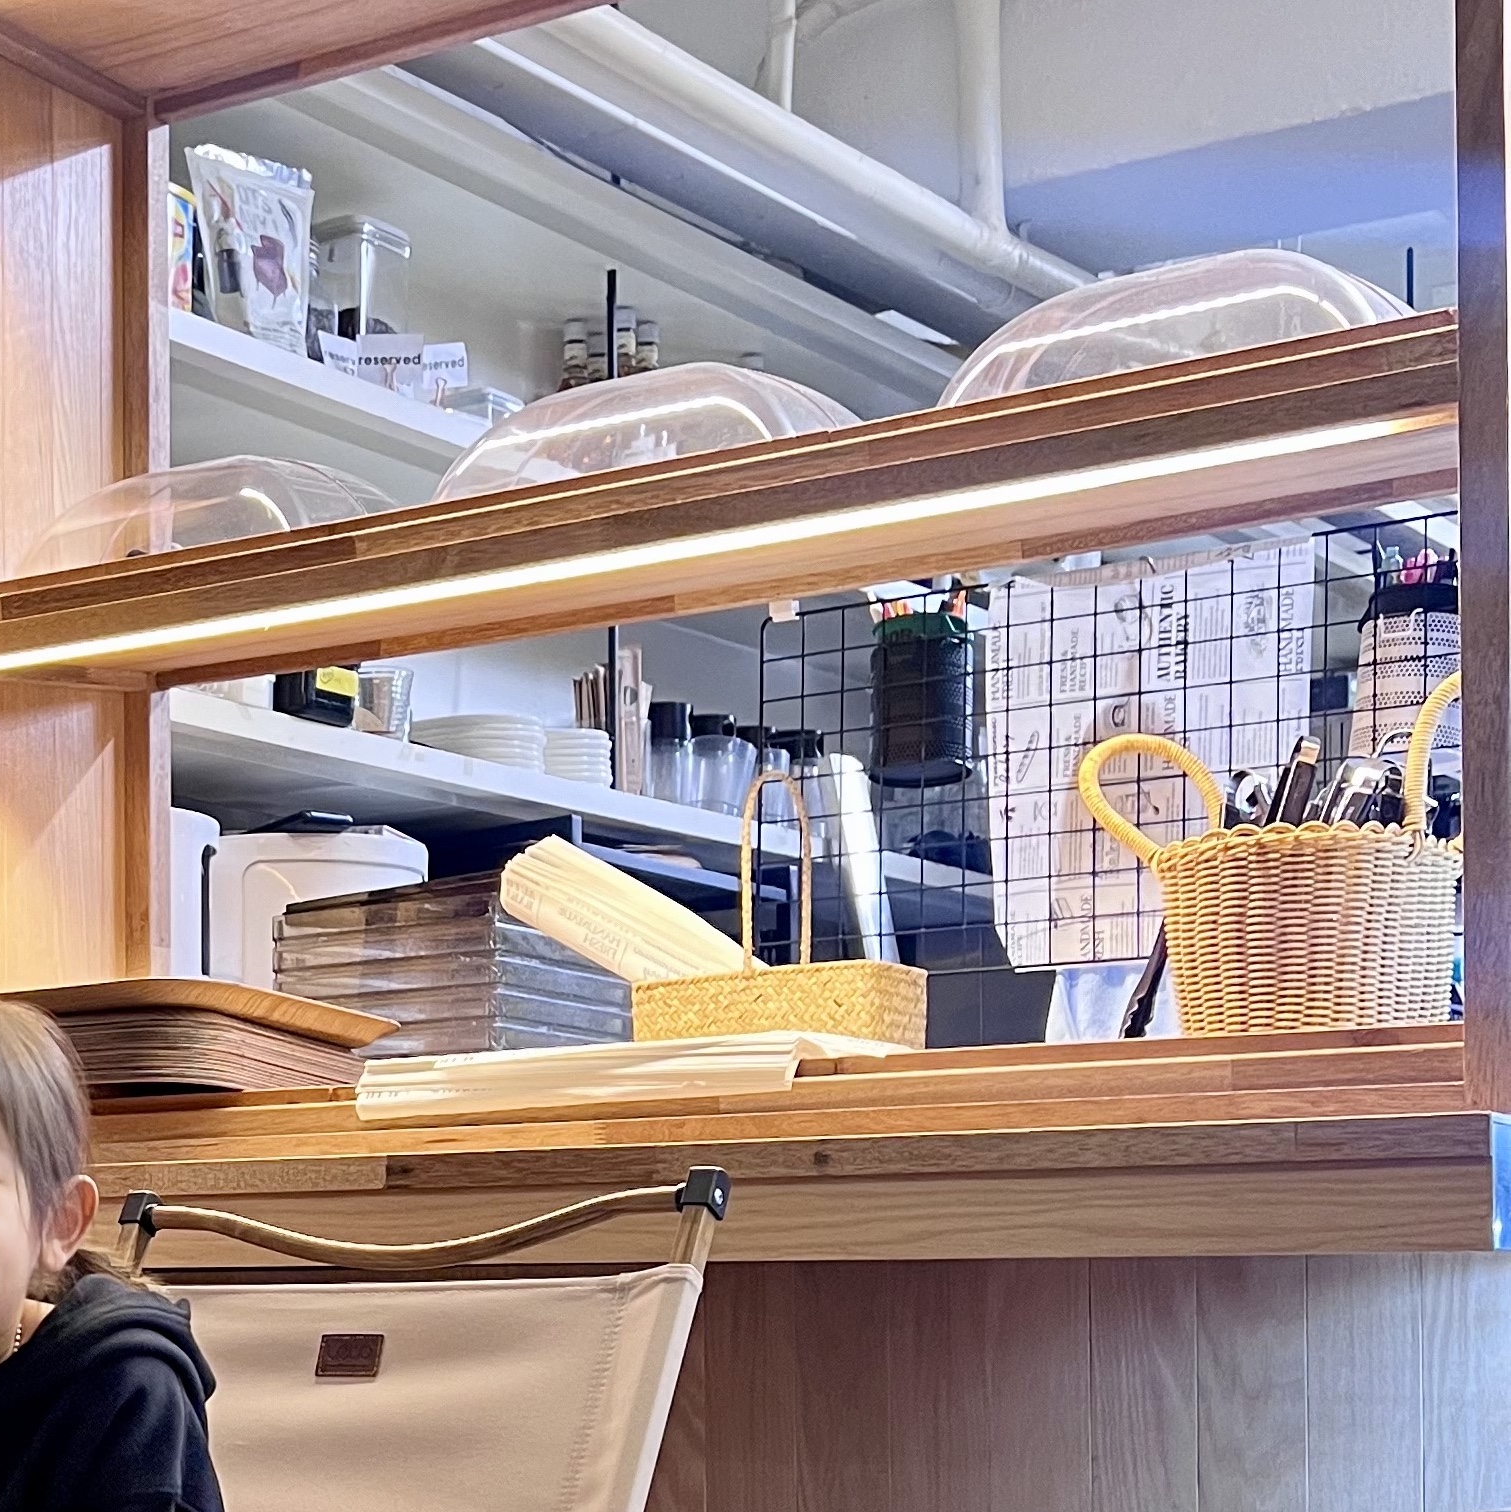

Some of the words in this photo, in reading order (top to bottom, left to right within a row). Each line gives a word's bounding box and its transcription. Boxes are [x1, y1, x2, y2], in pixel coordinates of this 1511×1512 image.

[358, 354, 421, 366] reserved
[422, 356, 465, 371] eserved
[1156, 584, 1175, 683] AUTHENTIC
